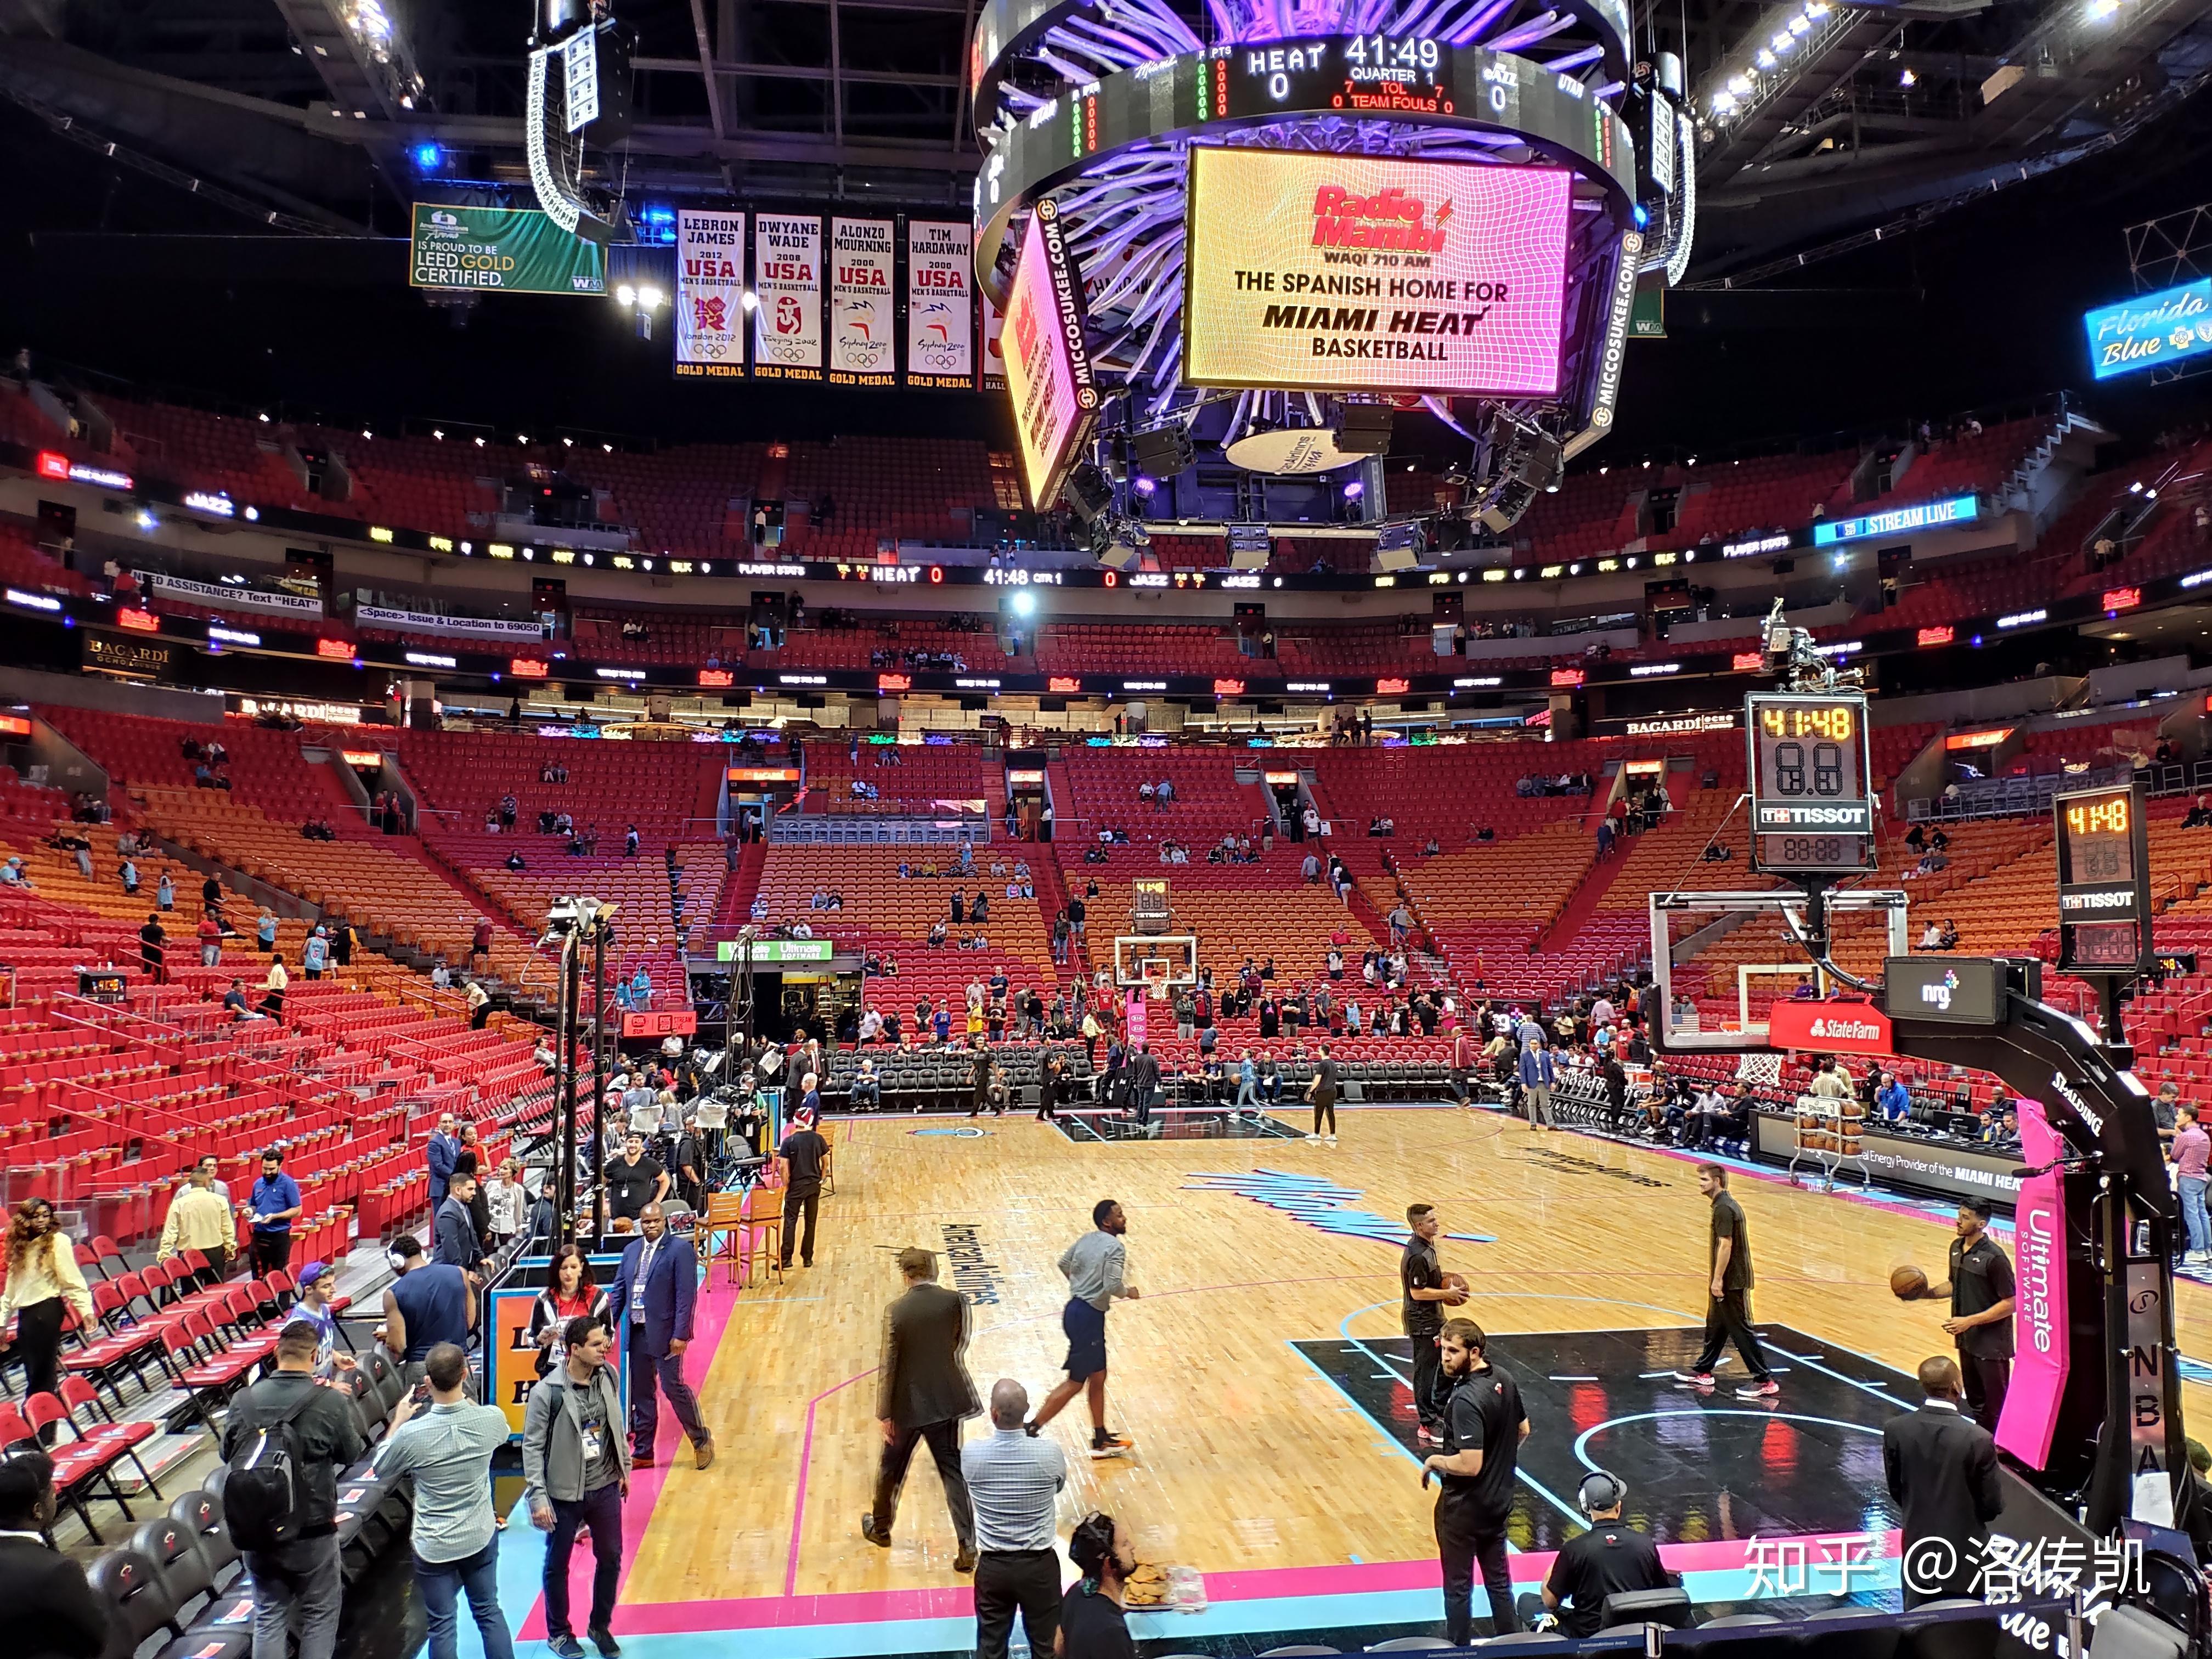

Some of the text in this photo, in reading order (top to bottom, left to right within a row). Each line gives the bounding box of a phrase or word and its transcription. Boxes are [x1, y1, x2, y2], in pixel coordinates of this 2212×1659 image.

[1211, 47, 1232, 58] PTS
[1250, 44, 1325, 73] HEAT
[1345, 35, 1438, 68] 41:49
[1351, 68, 1434, 84] QUARTER 1
[1270, 73, 1288, 98] 0
[1345, 81, 1443, 98] 7 TOL 7
[1333, 95, 1453, 113] 0 TEAM FOULS 0
[1492, 86, 1505, 109] 0
[1314, 185, 1424, 223] Radio
[684, 218, 738, 232] LEBRON
[759, 222, 819, 235] DWYANE
[840, 225, 885, 239] ALONZO
[687, 232, 736, 245] JAMES
[768, 234, 809, 248] WADE
[929, 229, 951, 241] TIM
[418, 241, 497, 255] IS PROUD TO BE
[834, 239, 891, 253] MOURNING
[912, 241, 968, 256] HARDAWAY
[417, 251, 515, 271] LEED GOLD
[699, 251, 722, 259] 2012
[851, 258, 874, 267] 2000
[1324, 252, 1431, 268] WAQI 710 AM
[686, 259, 736, 277] USA
[764, 262, 812, 280] USA
[929, 261, 952, 270] 2000
[415, 268, 505, 287] CERTIFIED.
[702, 278, 741, 286] BASKETBALL
[839, 266, 886, 286] USA
[917, 270, 964, 288] USA
[779, 283, 819, 292] BASKETBALL
[854, 286, 891, 295] BASKETBALL
[932, 289, 968, 298] BASKETBALL
[1235, 270, 1508, 301] THE SPANISH HOME FOR
[1045, 223, 1090, 383] MICCOSUKEE.COM
[1263, 304, 1491, 336] MIAMI HEAT
[2098, 292, 2209, 341] Florida
[715, 333, 736, 342] 2012
[1604, 253, 1638, 407] MICCOSUKEE.COM
[1312, 337, 1448, 362] BASKETBALL
[2101, 335, 2162, 366] Blue
[676, 365, 744, 377] GOLD MEDAL
[755, 367, 822, 380] GOLD MEDAL
[830, 373, 895, 386] GOLD MEDAL
[907, 375, 972, 388] GOLD MEDAL
[985, 381, 1006, 391] HALL
[1869, 500, 1957, 534] STREAM LIVE
[873, 567, 943, 583] HEAT 0
[984, 568, 1062, 585] 41:48 QTR 1
[1105, 572, 1168, 586] 0 JAZZ
[1221, 576, 1260, 588] JAZZ
[133, 571, 164, 585] NED
[167, 578, 243, 600] ASSISTANCE?
[247, 591, 272, 603] Text
[360, 607, 539, 633] <Space> Issue & Location to 69050
[1764, 708, 1850, 740] 41:48
[1790, 808, 1865, 823] TISSOT
[2069, 800, 2126, 834] 41:48
[2081, 891, 2134, 908] TISSOT
[780, 943, 822, 953] Ultimate
[1922, 984, 1951, 1009] nrg
[2052, 1072, 2104, 1137] SPALDING
[1870, 1150, 1895, 1169] Energy
[1896, 1155, 1927, 1172] Provider
[1929, 1162, 1938, 1174] of
[1939, 1164, 1953, 1177] the
[1955, 1167, 1993, 1186] MIAMI
[2019, 1231, 2032, 1322] SOFTWARE
[2030, 1209, 2053, 1352] Ultimate
[2134, 1344, 2160, 1476] NBA
